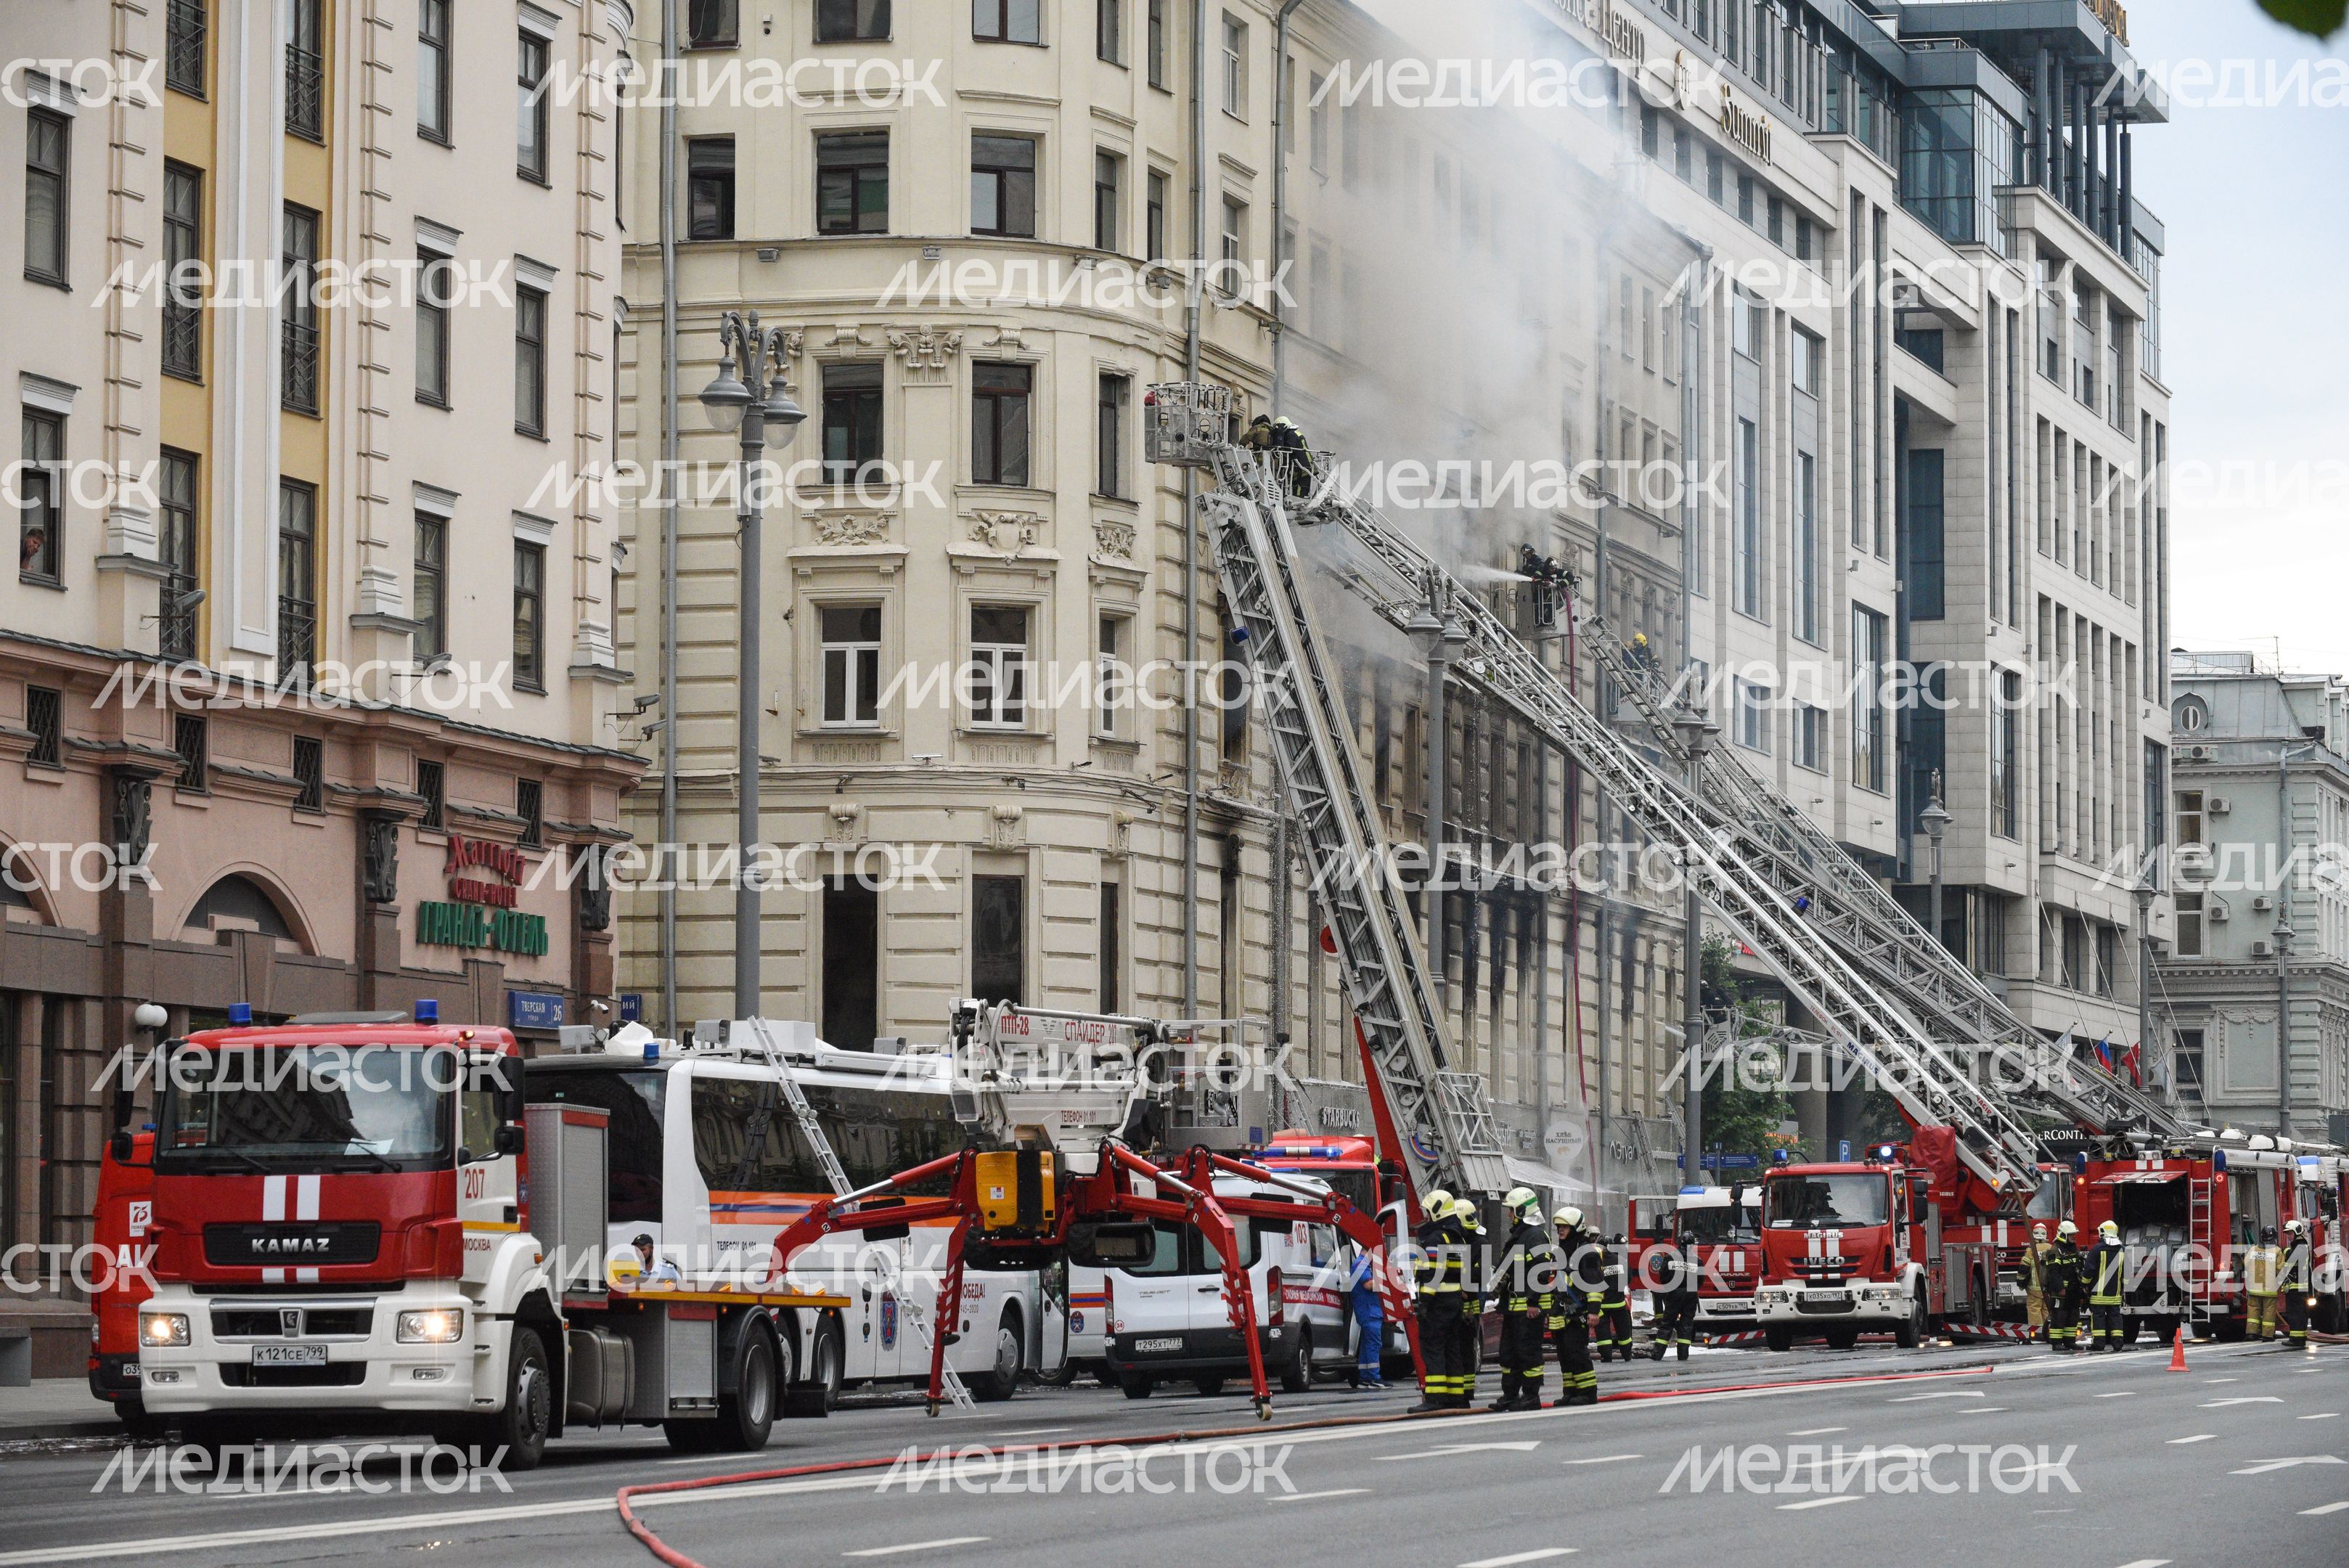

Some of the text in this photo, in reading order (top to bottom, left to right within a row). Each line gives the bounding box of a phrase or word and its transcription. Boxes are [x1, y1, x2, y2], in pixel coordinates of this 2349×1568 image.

[521, 1000, 545, 1013] ТВЕРСКАЯ
[553, 1004, 563, 1021] 26
[1810, 1005, 1829, 1024] ТЕЛЕФОН
[1001, 1015, 1029, 1036] ПТП-28
[1847, 1042, 1879, 1074] MAGIRUS
[1061, 1111, 1083, 1122] ТЕЛЕФОН
[1323, 1107, 1360, 1129] STARBUCKS
[465, 1169, 485, 1199] 207
[1295, 1223, 1307, 1244] 103
[252, 1238, 330, 1253] KAMAZ
[463, 1238, 491, 1251] МОСКВА
[1804, 1256, 1845, 1265] IVECO
[1138, 1340, 1167, 1349] Т295ХТ
[257, 1347, 324, 1360] К121СЕ 799
